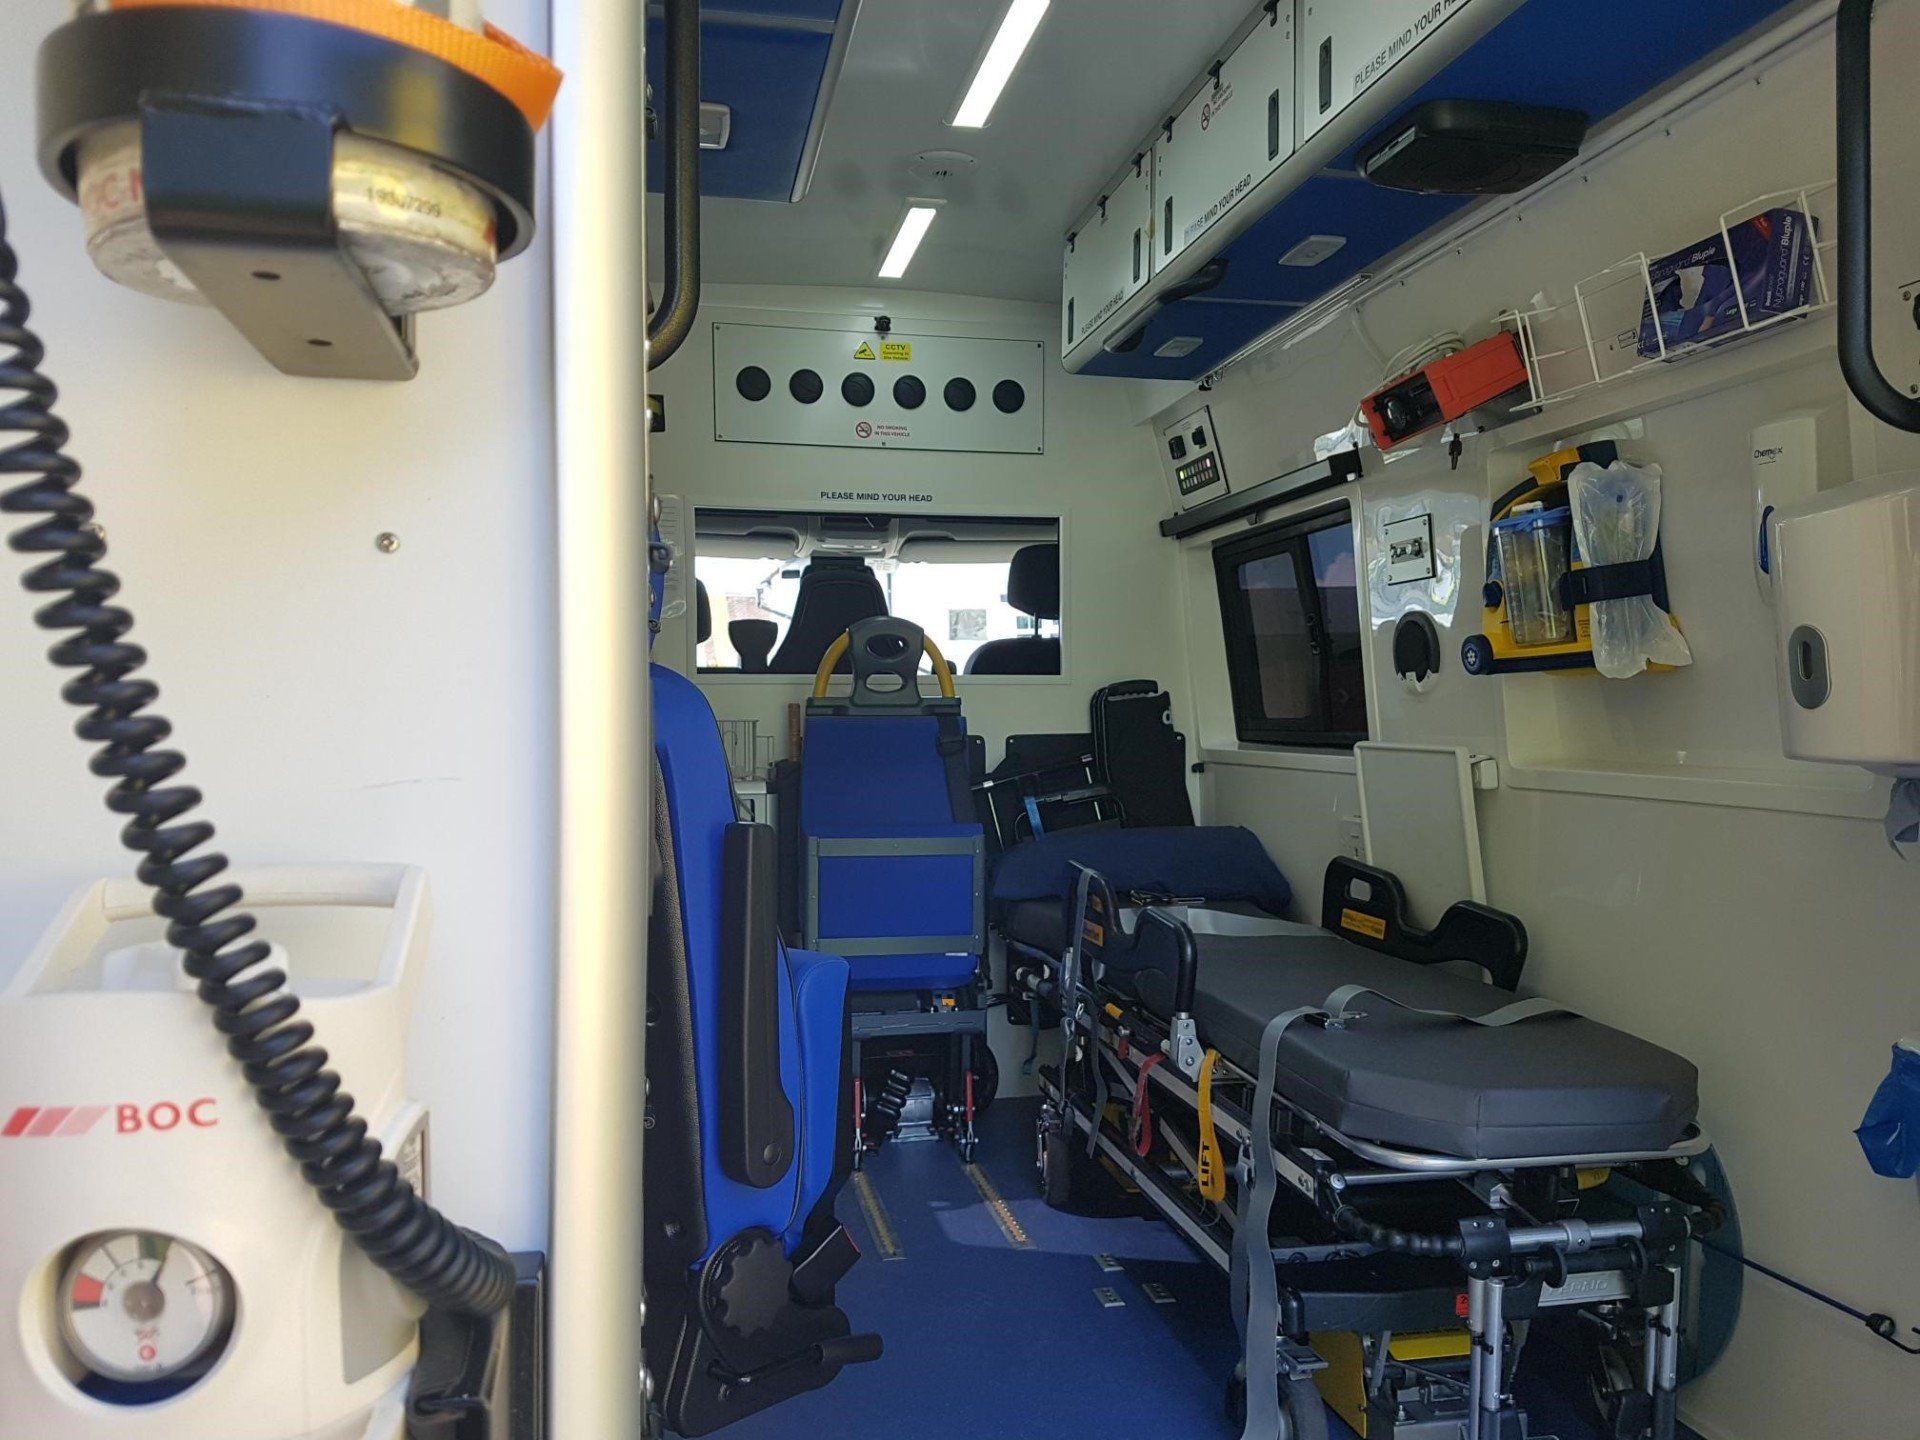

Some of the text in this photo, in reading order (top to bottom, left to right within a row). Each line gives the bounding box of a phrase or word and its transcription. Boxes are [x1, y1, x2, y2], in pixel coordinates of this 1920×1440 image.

[1355, 50, 1386, 89] PLEASE
[1389, 29, 1412, 59] MIND
[1414, 2, 1441, 35] YOUR
[1204, 204, 1218, 223] MIND
[1219, 189, 1234, 210] YOUR
[1235, 174, 1251, 196] HEAD
[820, 491, 933, 502] PLEASE MIND YOUR HEAD
[117, 1097, 219, 1133] BOC
[1201, 1141, 1210, 1187] LIFT
